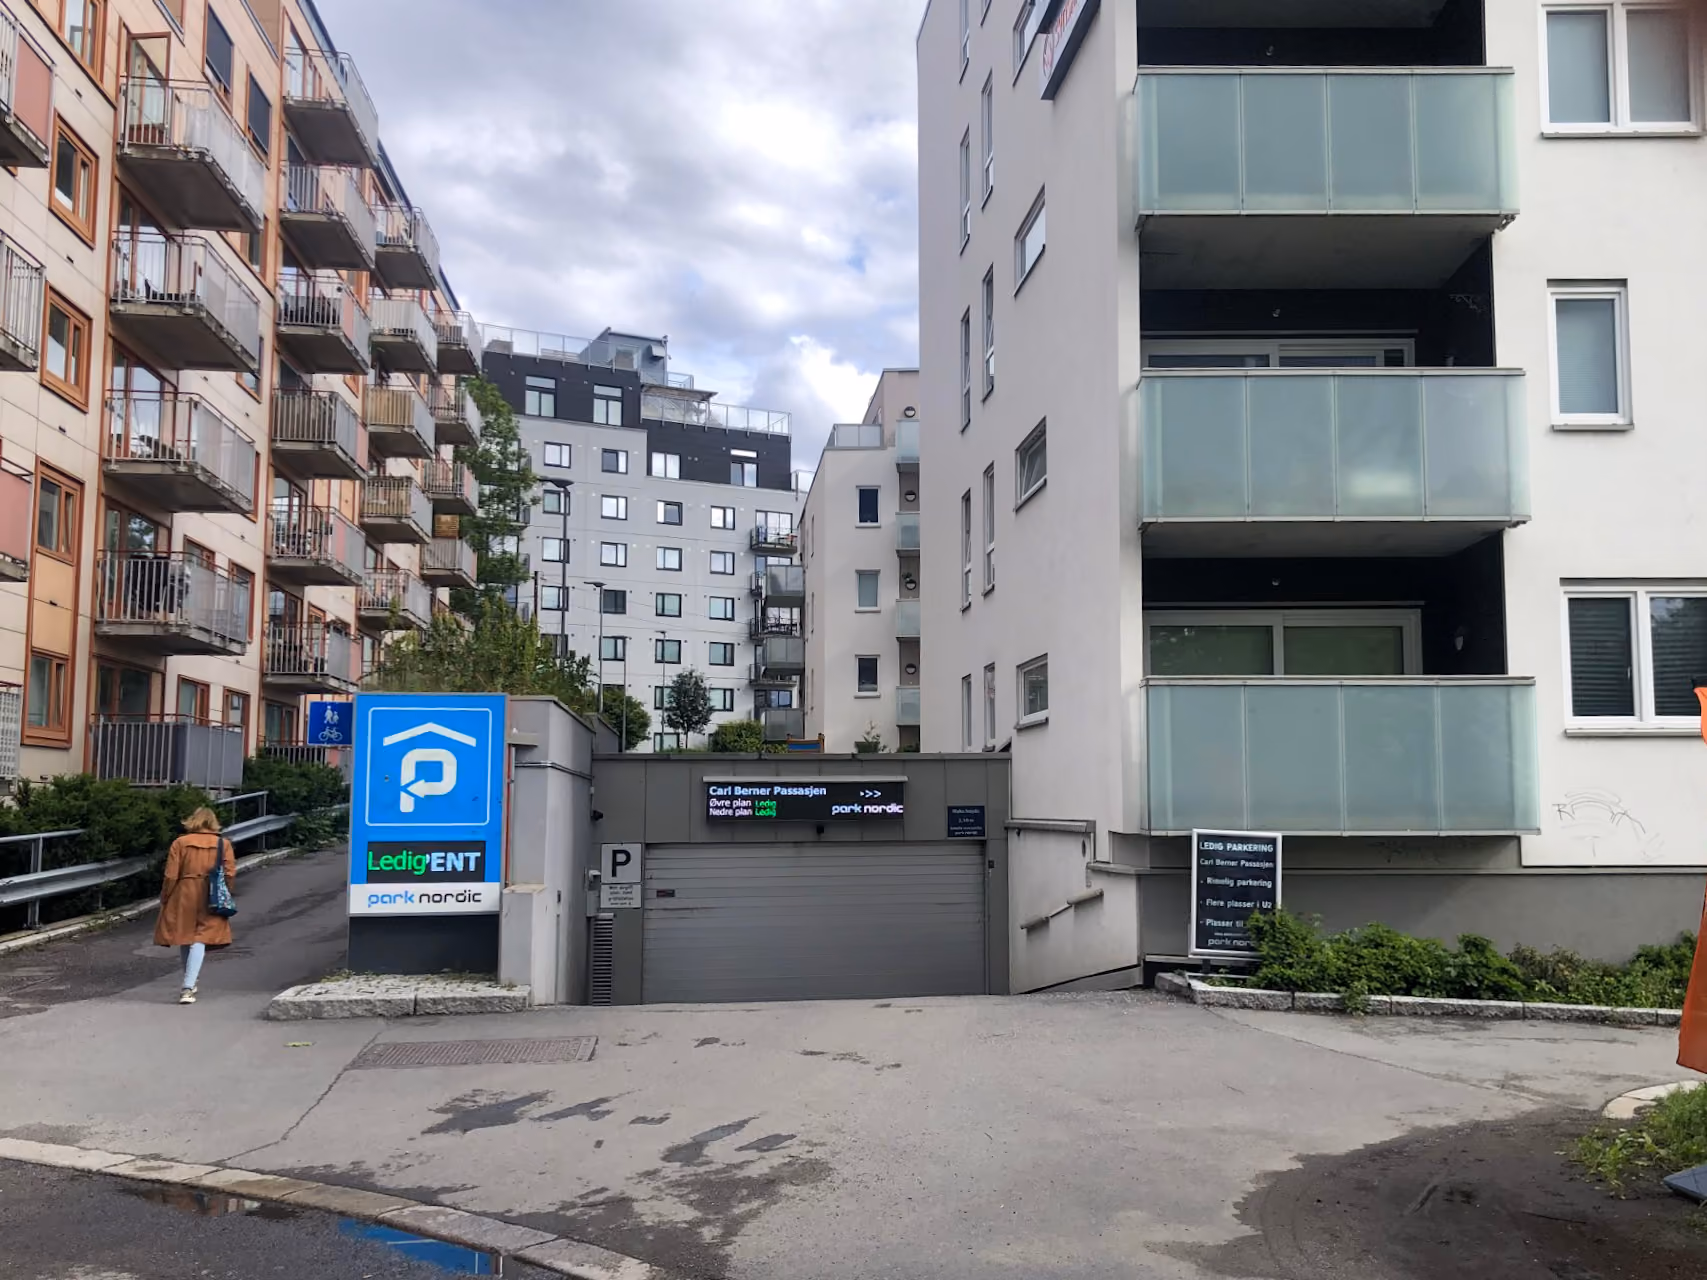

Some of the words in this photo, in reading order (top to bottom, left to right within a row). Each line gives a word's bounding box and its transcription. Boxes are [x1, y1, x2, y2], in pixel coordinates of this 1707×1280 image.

[709, 786, 732, 795] Carl
[734, 786, 772, 796] Berner
[774, 786, 827, 798] Passasjen
[709, 798, 731, 807] Øvre
[732, 798, 752, 809] plan
[831, 803, 862, 815] park
[863, 803, 904, 814] nordic
[709, 808, 734, 816] Nedre
[735, 808, 753, 817] plan
[1199, 841, 1224, 851] LEDIG
[1226, 843, 1274, 852] PARKERING
[611, 849, 632, 878] P
[1200, 858, 1214, 866] Carl
[1215, 859, 1239, 867] Berner
[1240, 860, 1275, 869] Passasjen
[1236, 878, 1273, 889] parkering
[367, 890, 415, 908] park
[418, 889, 482, 904] nordic
[1206, 898, 1225, 907] Flere
[1226, 900, 1255, 909] plasser
[1206, 918, 1233, 927] Plasser
[1207, 938, 1231, 947] park
